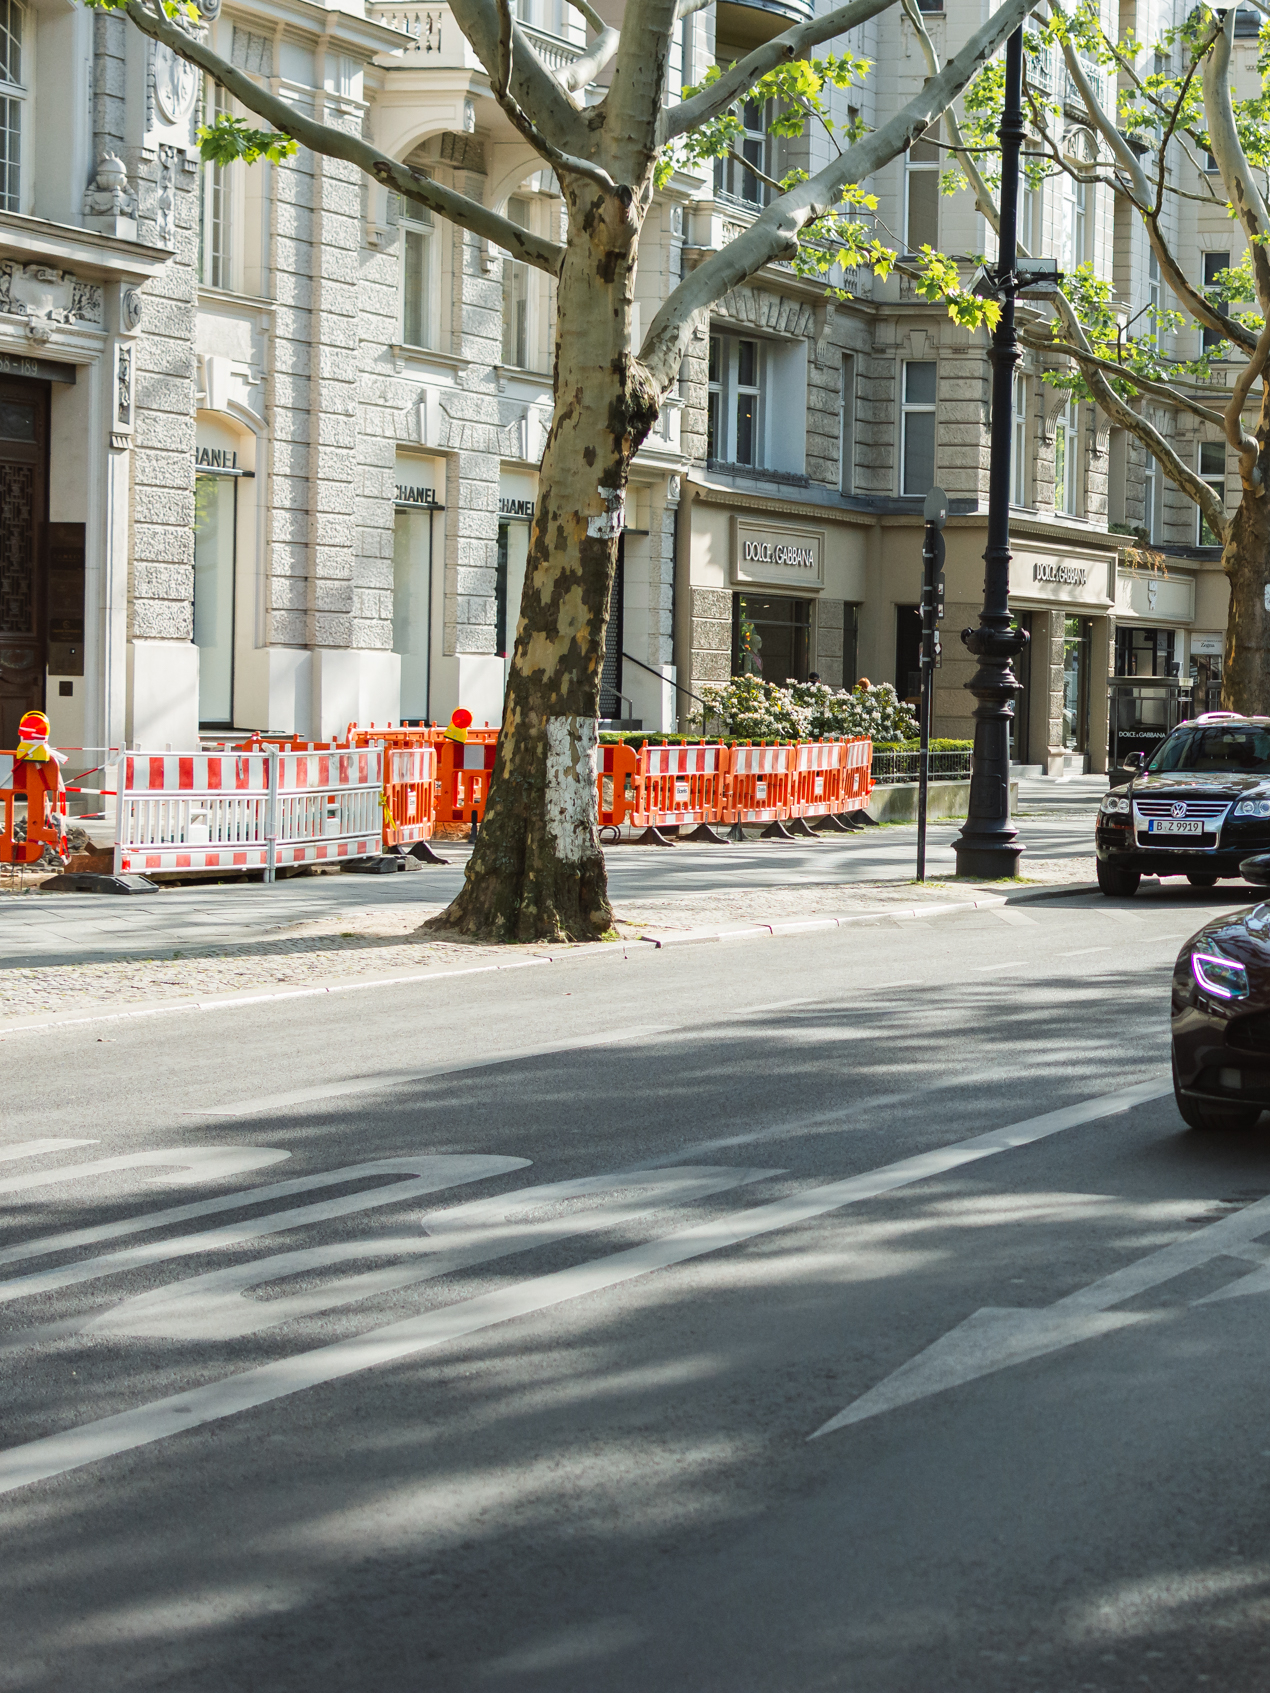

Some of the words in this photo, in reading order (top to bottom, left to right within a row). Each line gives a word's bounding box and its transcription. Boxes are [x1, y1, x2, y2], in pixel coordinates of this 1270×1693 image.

[744, 541, 771, 562] DOLCE
[775, 545, 814, 567] GABBANA
[1156, 821, 1163, 831] B
[1168, 822, 1174, 831] Z
[1176, 823, 1199, 832] 9919
